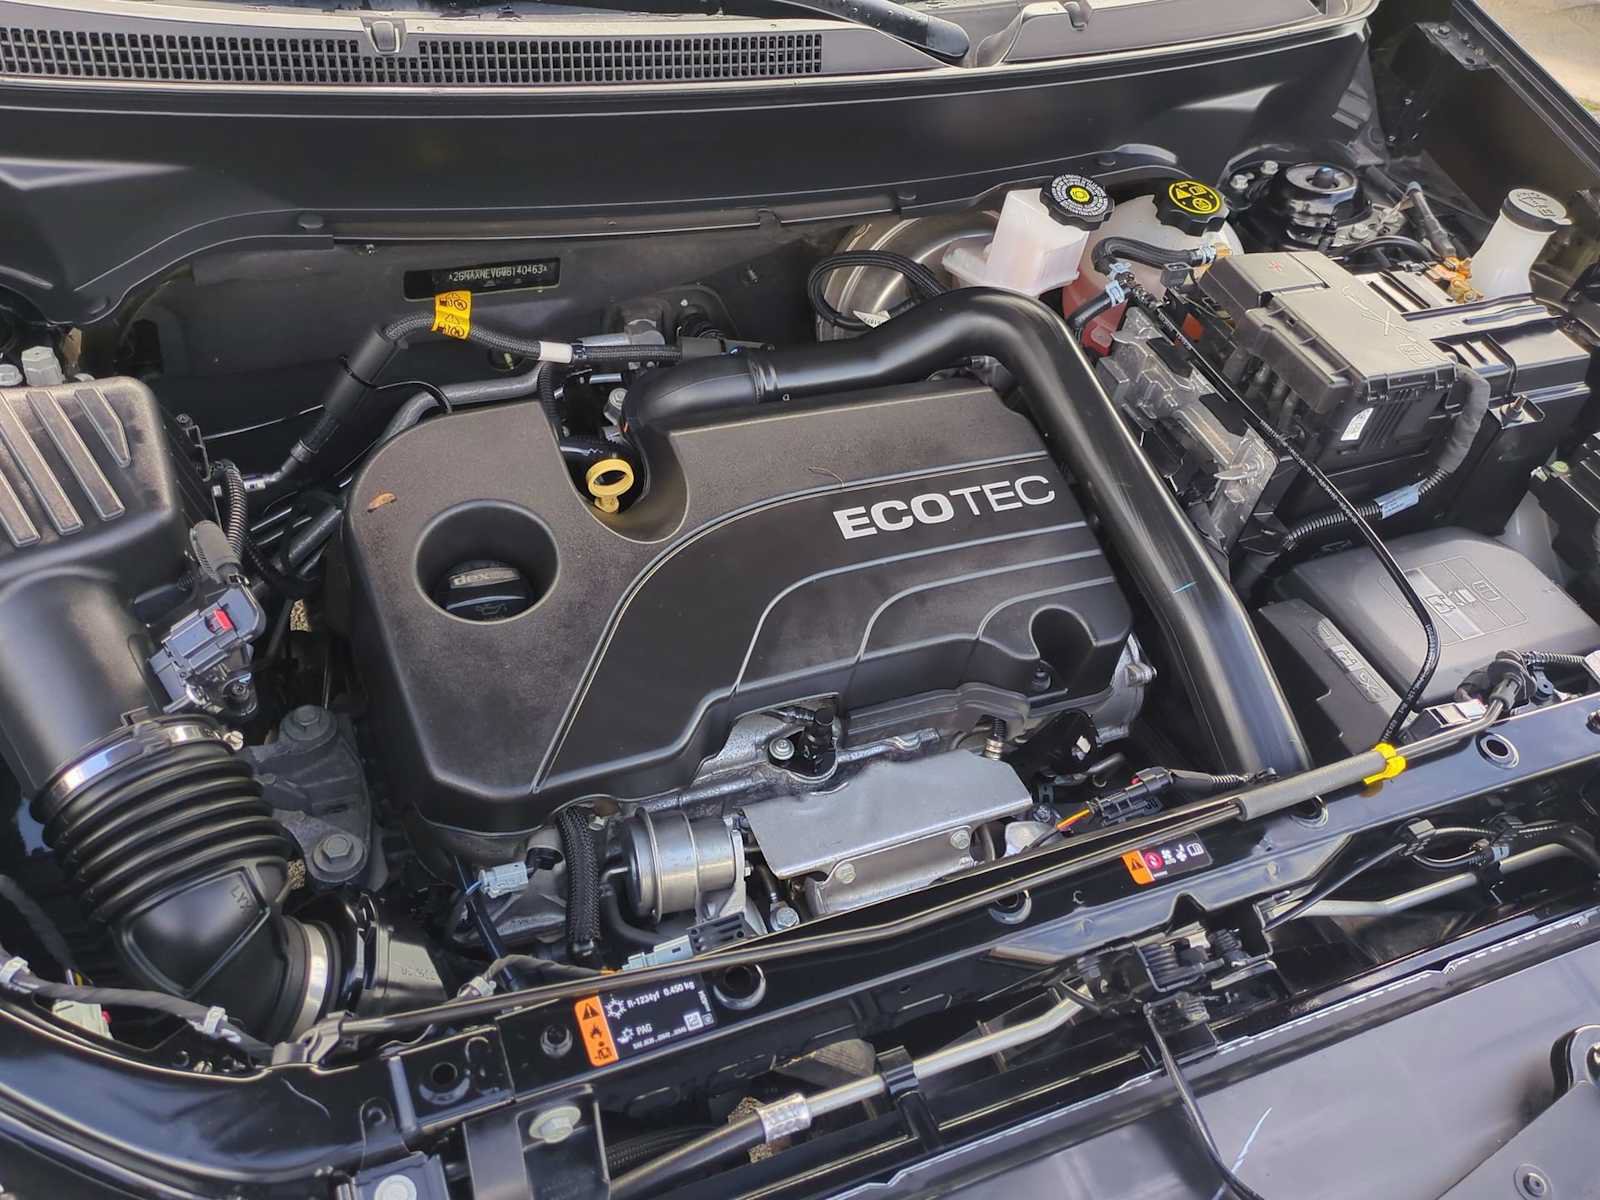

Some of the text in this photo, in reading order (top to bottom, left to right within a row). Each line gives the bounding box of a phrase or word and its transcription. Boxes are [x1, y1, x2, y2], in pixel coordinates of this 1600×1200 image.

[833, 475, 1055, 540] ECOTEC
[626, 981, 696, 1008] R-1234yf 0.450 kg
[635, 1023, 653, 1036] PAG
